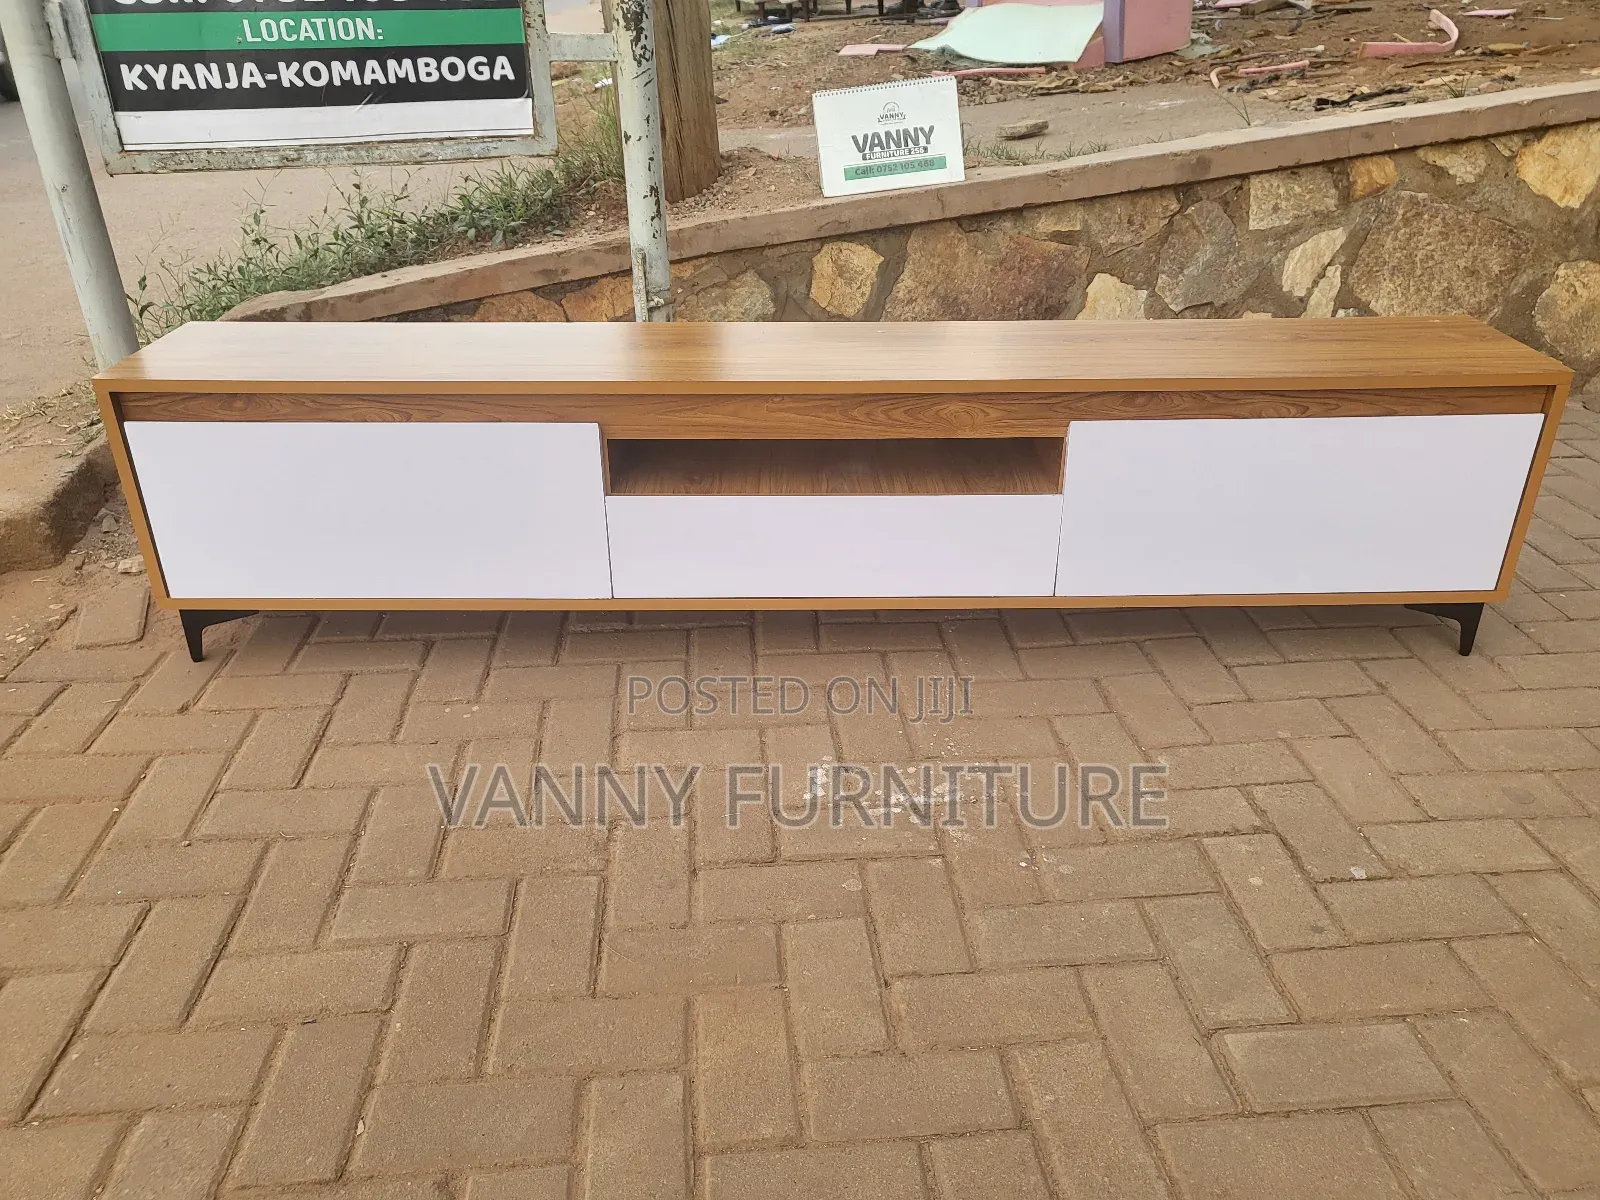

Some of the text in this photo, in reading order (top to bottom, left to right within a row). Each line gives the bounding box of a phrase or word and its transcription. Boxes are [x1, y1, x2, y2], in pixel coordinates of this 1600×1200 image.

[242, 17, 384, 42] LOCATION:
[119, 55, 515, 91] KYANJA-KOMAMBOGA
[852, 125, 935, 153] VANNY
[866, 146, 924, 160] FURNITURE 256
[855, 167, 875, 176] Call:
[876, 163, 898, 173] 0752
[900, 161, 915, 170] 105
